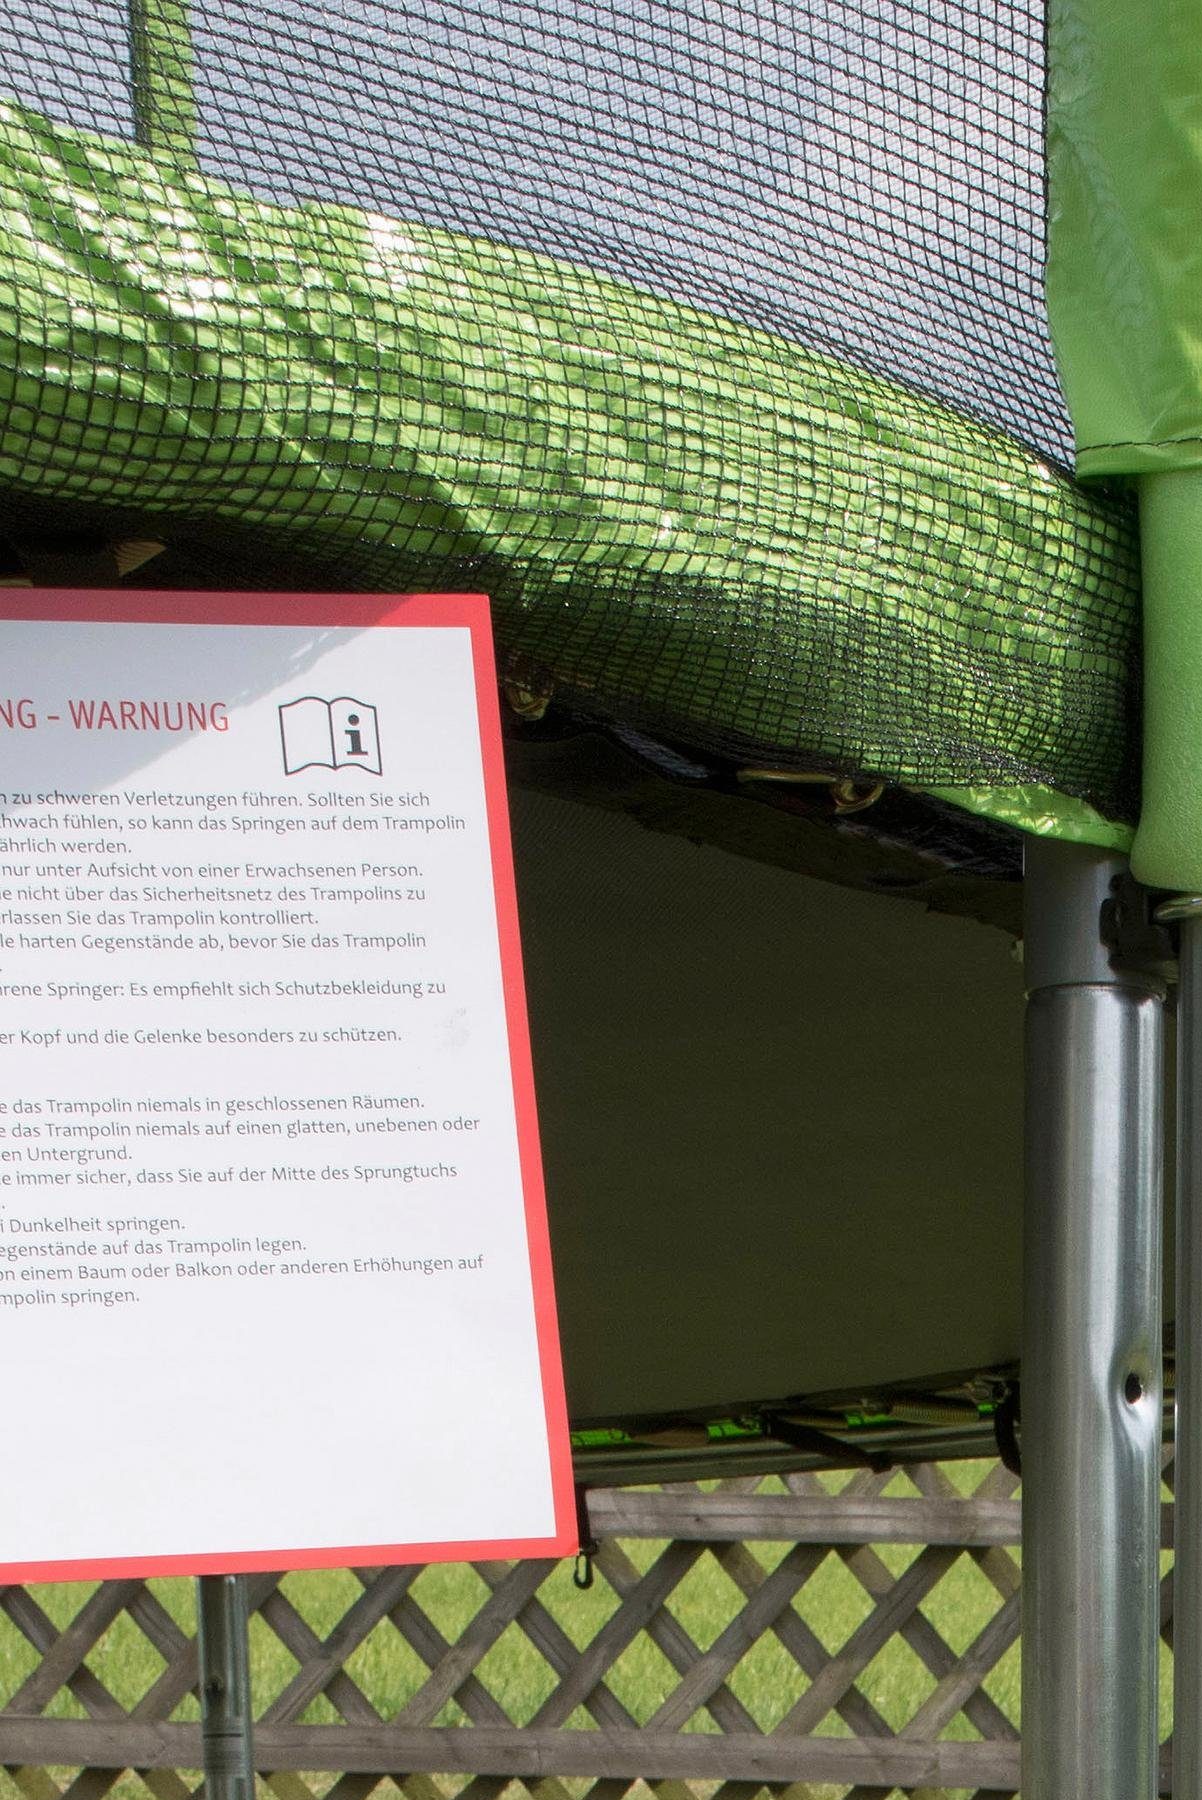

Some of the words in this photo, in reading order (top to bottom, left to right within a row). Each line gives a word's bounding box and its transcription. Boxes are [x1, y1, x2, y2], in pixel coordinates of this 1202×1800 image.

[67, 699, 230, 733] WARNUNG
[11, 792, 32, 805] zu
[36, 789, 121, 806] schweren
[122, 790, 238, 812] Verletzungen
[241, 791, 303, 809] führen.
[306, 791, 366, 808] Sollten
[369, 792, 394, 808] Sie
[398, 791, 430, 807] sich
[0, 811, 59, 830] hwach
[62, 813, 124, 833] fühlen,
[127, 817, 148, 831] so
[151, 814, 194, 830] kann
[197, 814, 228, 831] das
[231, 815, 307, 836] Springen
[310, 815, 338, 831] auf
[341, 815, 379, 831] dem
[381, 814, 466, 835] Trampolin
[60, 837, 132, 854] werden.
[1, 864, 32, 877] nur
[35, 863, 83, 878] unter
[86, 861, 158, 879] Aufsicht
[160, 866, 194, 879] von
[198, 862, 241, 879] einer
[244, 862, 357, 879] Erwachsenen
[361, 862, 424, 878] Person.
[16, 885, 61, 902] nicht
[64, 885, 105, 902] über
[108, 885, 139, 902] das
[142, 885, 273, 902] Sicherheitsnetz
[277, 885, 307, 902] des
[309, 885, 403, 905] Trampolins
[406, 889, 426, 901] zu
[66, 909, 92, 926] Sie
[96, 909, 126, 926] das
[128, 909, 215, 930] Trampolin
[218, 909, 319, 926] kontrolliert.
[18, 932, 77, 949] harten
[81, 933, 195, 954] Gegenstände
[198, 933, 224, 952] ab,
[228, 933, 278, 950] bevor
[281, 933, 307, 949] Sie
[310, 932, 340, 949] das
[342, 932, 427, 952] Trampolin
[46, 981, 125, 1002] Springer:
[129, 982, 149, 997] Es
[152, 980, 235, 1001] empfiehlt
[238, 980, 271, 997] sich
[274, 979, 424, 1000] Schutzbekleidung
[426, 982, 446, 994] zu
[20, 1028, 62, 1049] Kopf
[66, 1028, 100, 1045] und
[103, 1028, 130, 1045] die
[133, 1028, 203, 1045] Gelenke
[205, 1027, 295, 1044] besonders
[298, 1031, 319, 1043] zu
[322, 1026, 402, 1043] schützen.
[12, 1098, 43, 1115] das
[45, 1097, 133, 1118] Trampolin
[136, 1096, 202, 1113] niemals
[205, 1097, 221, 1112] in
[225, 1095, 348, 1117] geschlossenen
[352, 1094, 425, 1110] Räumen.
[11, 1122, 41, 1139] das
[44, 1121, 132, 1142] Trampolin
[135, 1120, 201, 1137] niemals
[204, 1119, 232, 1136] auf
[236, 1120, 282, 1136] einen
[286, 1119, 351, 1139] glatten,
[355, 1116, 438, 1134] unebenen
[442, 1115, 481, 1132] oder
[26, 1144, 133, 1166] Untergrund.
[15, 1170, 72, 1186] immer
[75, 1168, 132, 1187] sicher,
[135, 1168, 174, 1184] dass
[177, 1168, 203, 1183] Sie
[207, 1166, 235, 1183] auf
[238, 1166, 267, 1182] der
[271, 1166, 317, 1182] Mitte
[320, 1164, 350, 1181] des
[353, 1161, 458, 1184] Sprungtuchs
[9, 1216, 103, 1234] Dunkelheit
[105, 1216, 186, 1236] springen.
[101, 1239, 129, 1256] auf
[134, 1239, 164, 1255] das
[166, 1237, 252, 1258] Trampolin
[255, 1236, 307, 1257] legen.
[20, 1265, 73, 1281] einem
[77, 1264, 127, 1280] Baum
[130, 1262, 171, 1279] oder
[175, 1261, 233, 1278] Balkon
[237, 1260, 277, 1277] oder
[279, 1258, 349, 1275] anderen
[353, 1256, 454, 1276] Erhöhungen
[457, 1253, 484, 1270] auf
[60, 1288, 140, 1308] springen.
